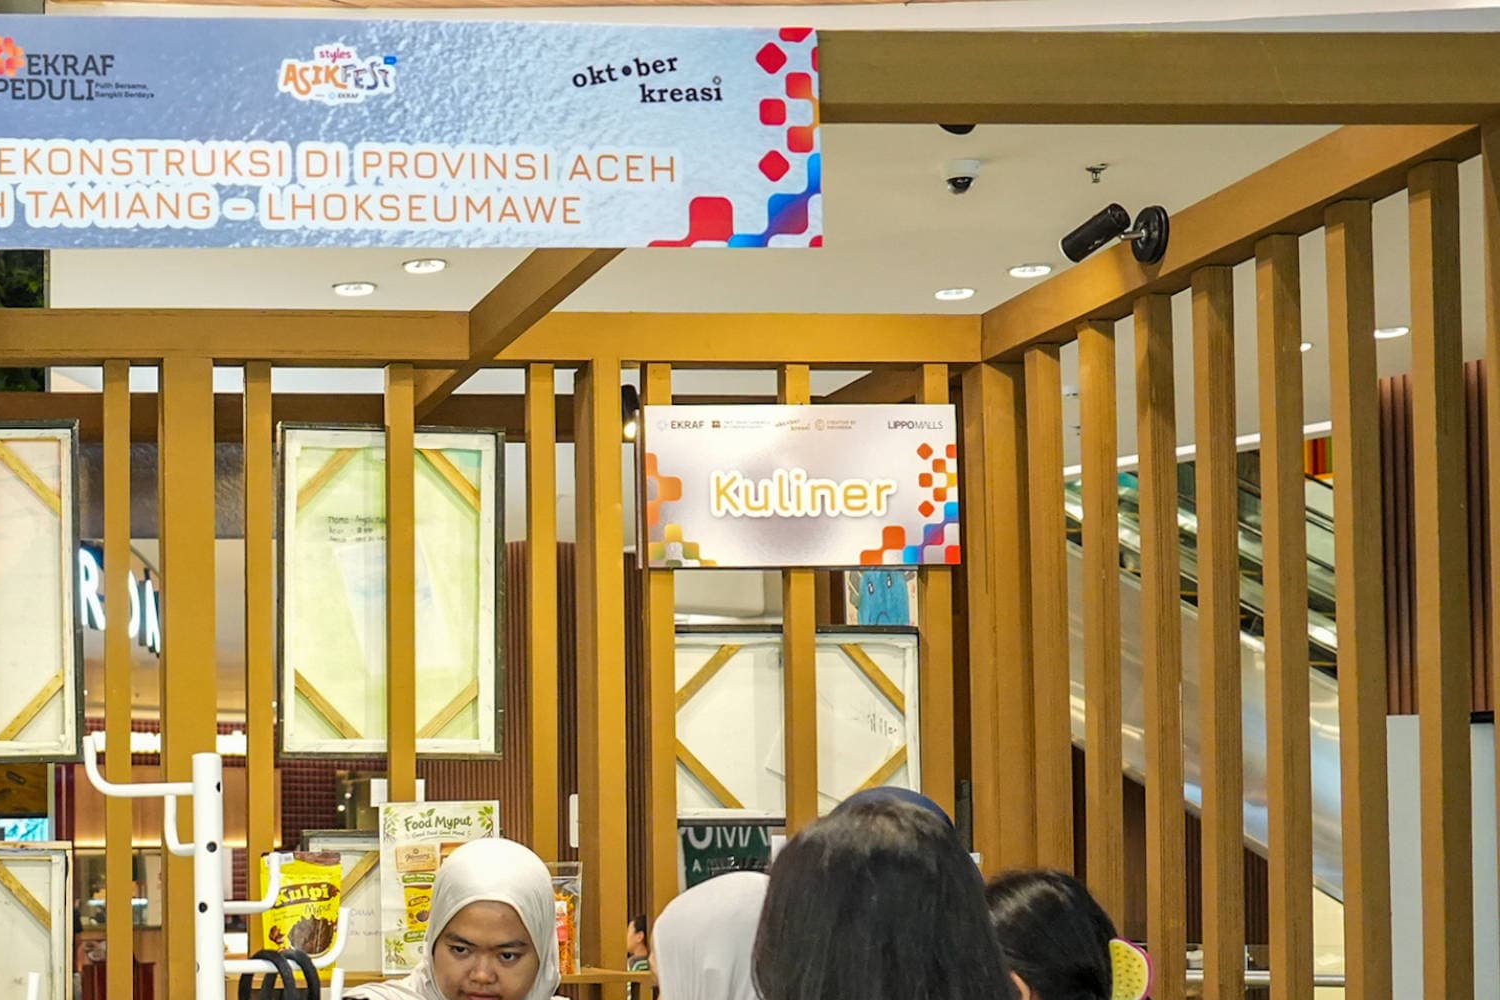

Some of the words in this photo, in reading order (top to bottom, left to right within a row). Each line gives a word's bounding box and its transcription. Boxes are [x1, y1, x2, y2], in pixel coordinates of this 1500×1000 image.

[26, 54, 115, 76] EKRAF
[319, 48, 352, 63] styles
[640, 75, 723, 103] kreasi
[305, 149, 341, 178] DI
[362, 150, 550, 181] PROVINSI
[569, 154, 676, 183] ACEH
[26, 191, 212, 220] TAMIANG
[268, 193, 581, 224] LHOKSEUMAWE
[670, 420, 705, 430] EKRAF
[715, 473, 893, 511] Kuliner
[404, 815, 432, 832] Food
[435, 815, 473, 830] Myput
[276, 883, 330, 905] Kulpi
